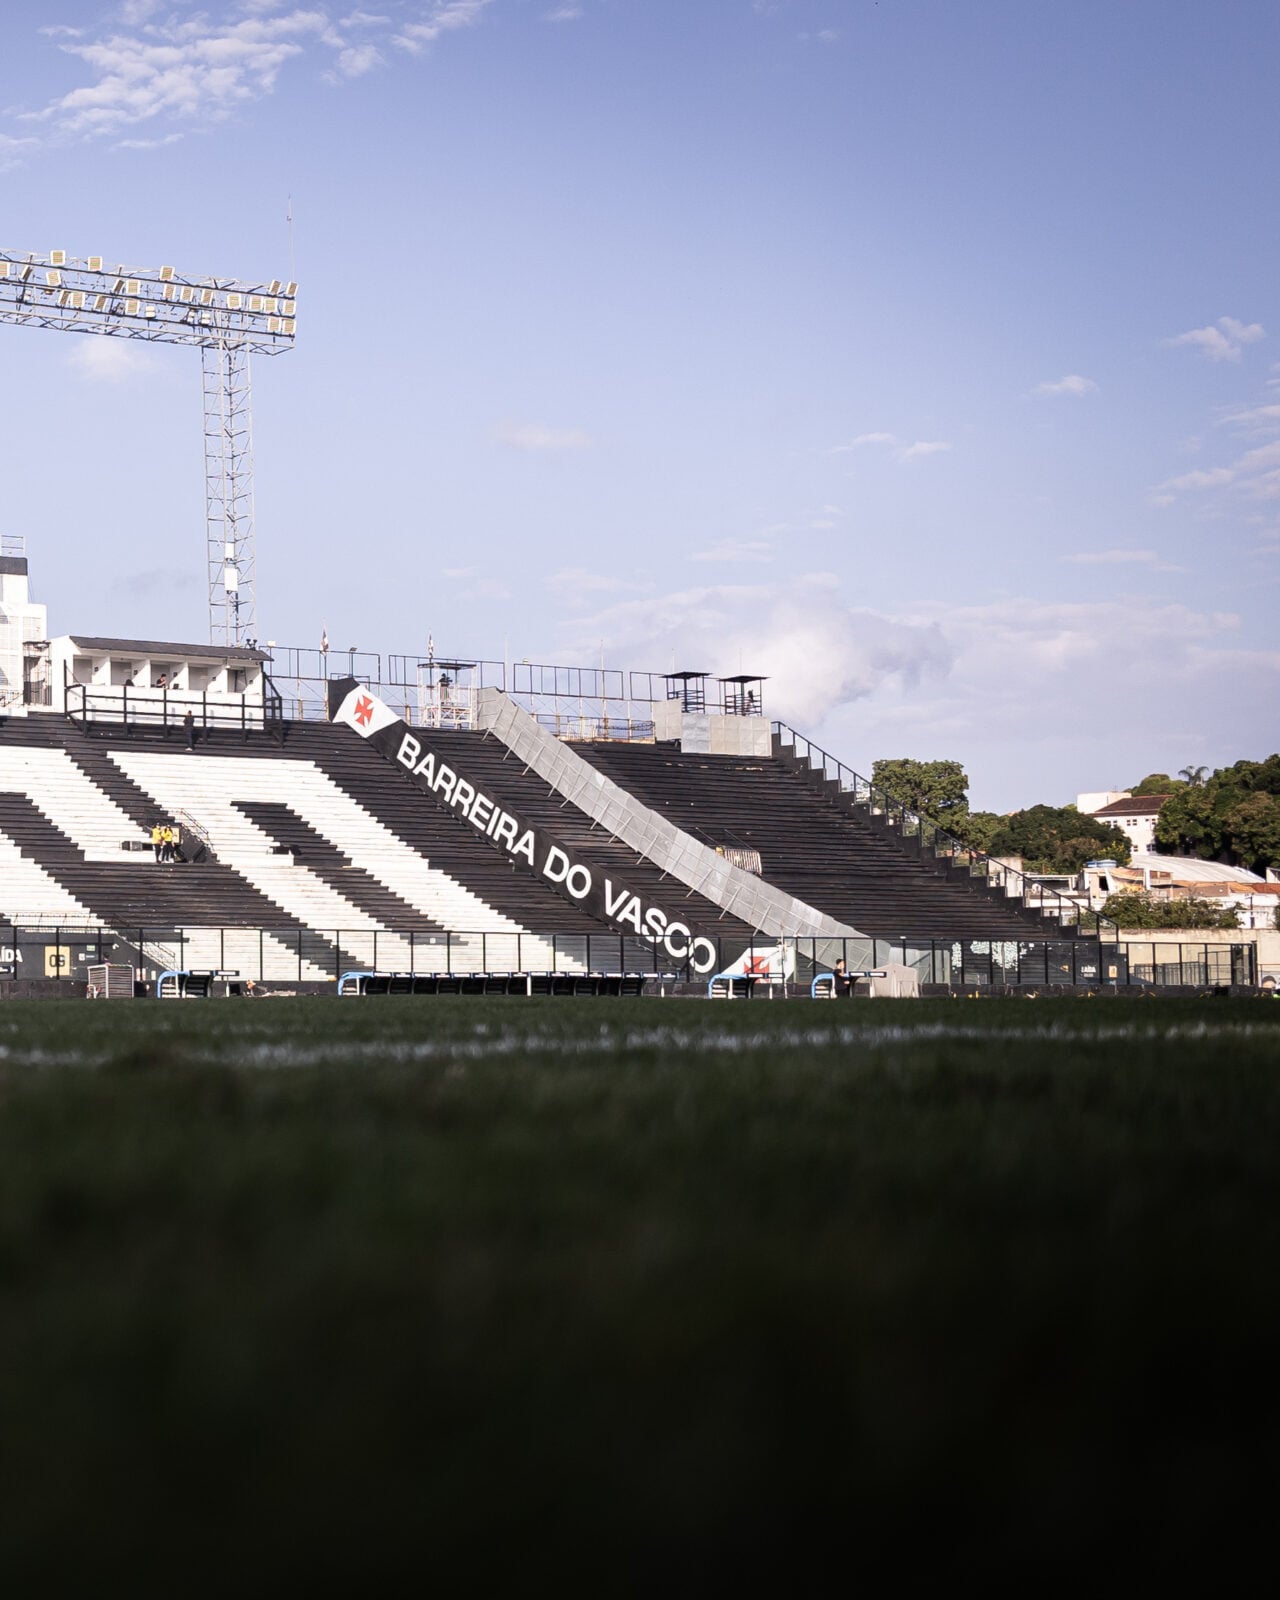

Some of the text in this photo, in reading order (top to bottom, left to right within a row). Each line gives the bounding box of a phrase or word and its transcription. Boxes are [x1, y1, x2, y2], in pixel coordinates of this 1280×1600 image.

[396, 732, 717, 974] BARREIRA DO VASCO
